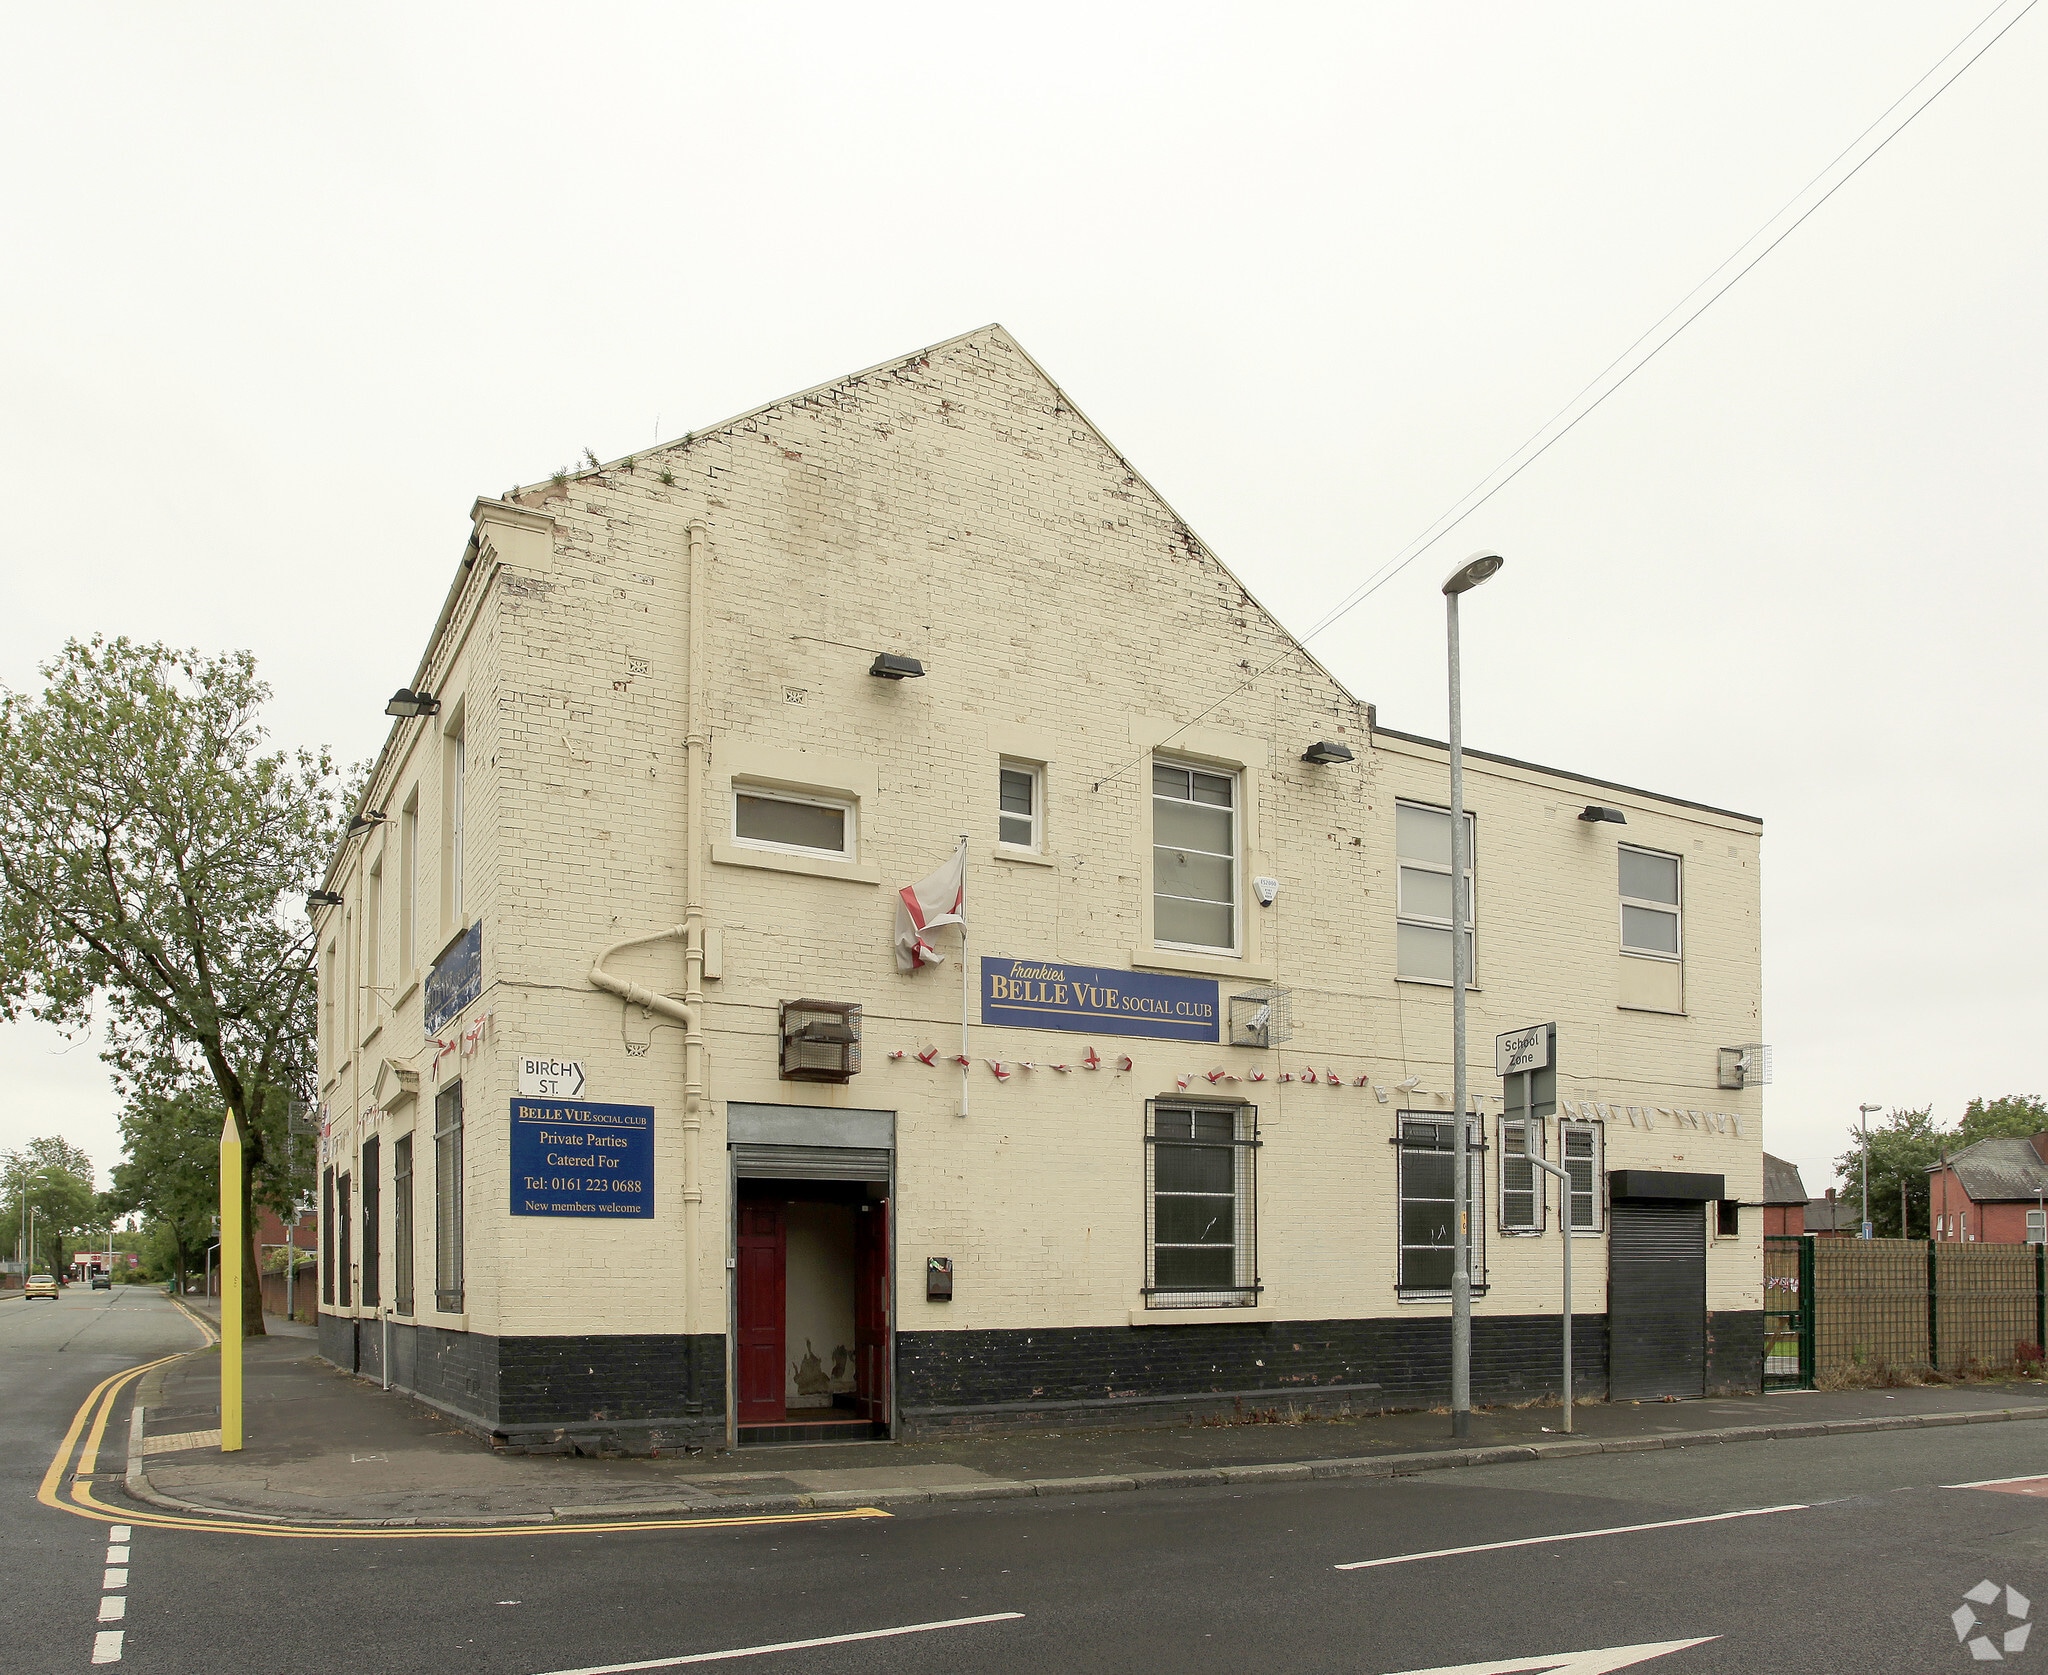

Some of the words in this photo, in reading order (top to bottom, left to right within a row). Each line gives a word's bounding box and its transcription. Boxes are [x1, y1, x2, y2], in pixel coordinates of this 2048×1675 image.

[1010, 961, 1066, 982] Frankies
[990, 974, 1068, 1005] BELLE
[1071, 982, 1120, 1010] VUE
[1122, 996, 1173, 1014] SOCIAL
[1176, 1001, 1213, 1018] CLUB
[1505, 1033, 1539, 1052] School
[1509, 1053, 1534, 1066] Zone
[525, 1060, 572, 1077] BIRCH
[539, 1079, 559, 1095] ST.
[518, 1106, 563, 1121] BELLE
[564, 1109, 592, 1122] VUE
[592, 1113, 623, 1124] SOCIAL
[624, 1116, 647, 1125] CLUB
[539, 1131, 583, 1146] Private
[586, 1133, 628, 1148] Parties
[546, 1152, 595, 1167] Catered
[598, 1155, 620, 1169] For
[524, 1176, 548, 1190] Tel:
[551, 1177, 581, 1191] 0161
[586, 1178, 609, 1192] 223
[612, 1179, 642, 1193] 0688
[525, 1200, 549, 1211] New
[551, 1200, 596, 1212] members
[598, 1202, 641, 1213] welcome
